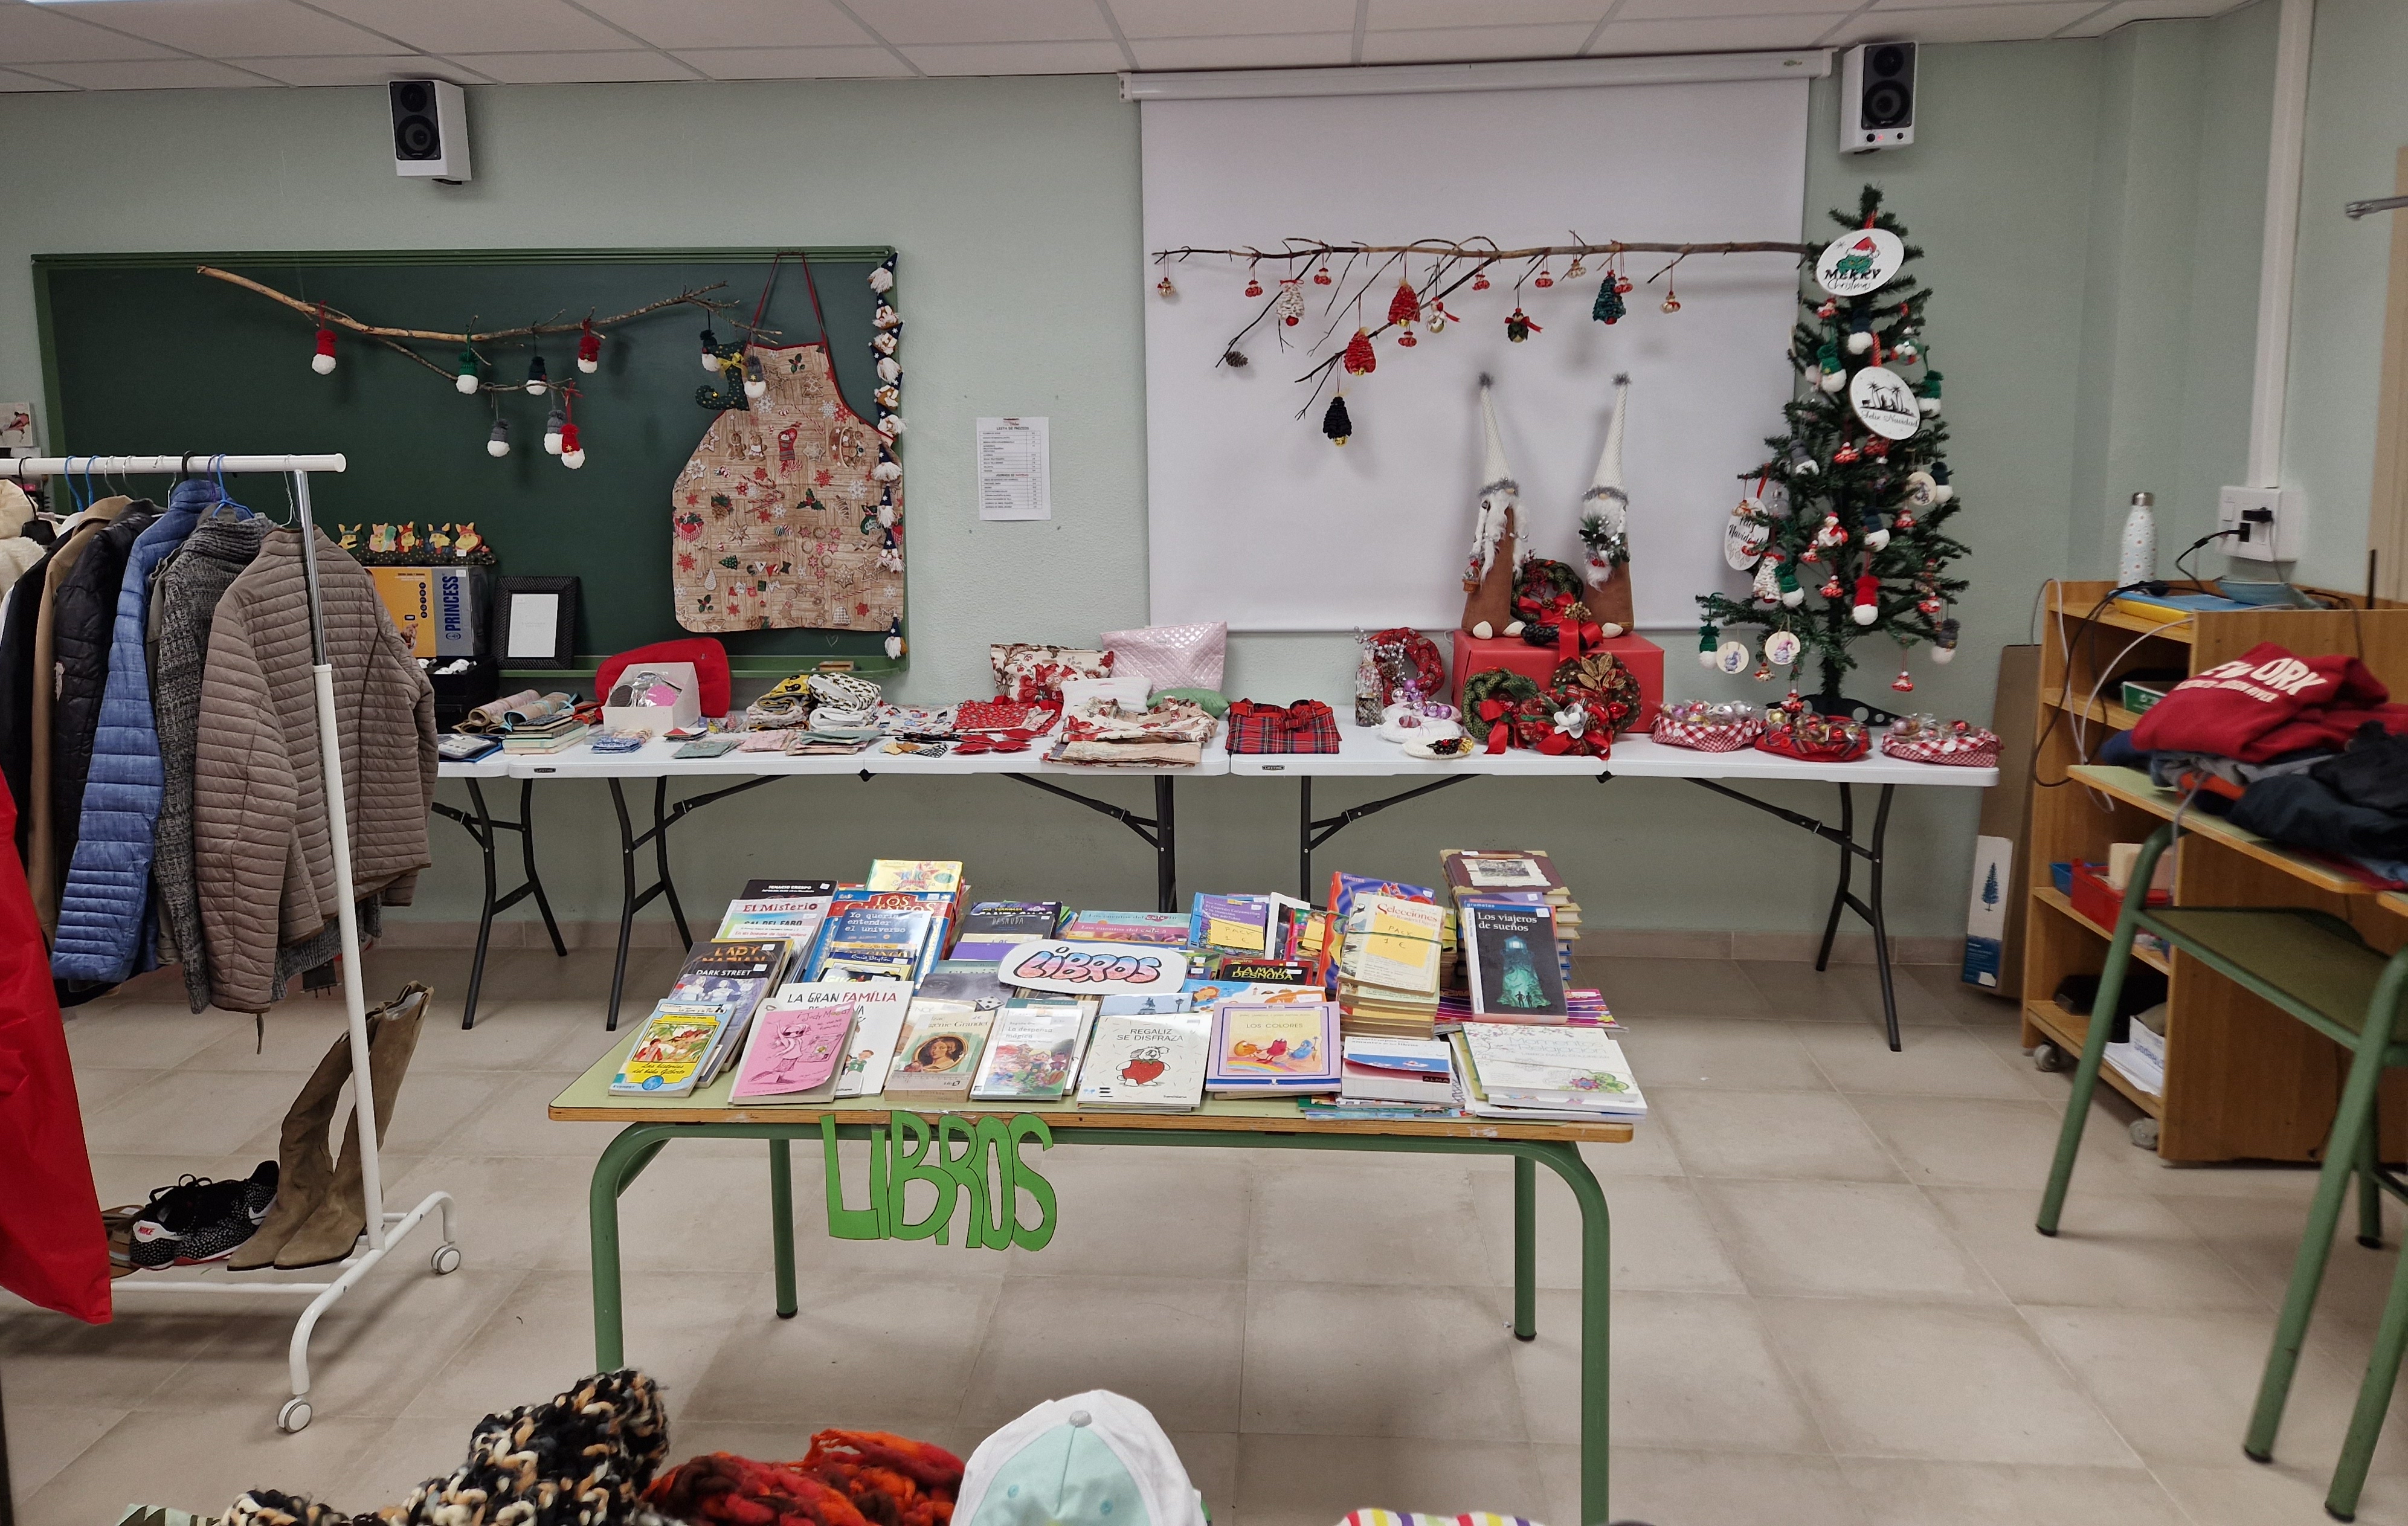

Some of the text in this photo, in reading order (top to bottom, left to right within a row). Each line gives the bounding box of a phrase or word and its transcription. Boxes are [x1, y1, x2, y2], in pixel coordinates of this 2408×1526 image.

[1824, 267, 1881, 281] MERRY
[1826, 278, 1873, 291] Christmas
[1861, 410, 1920, 427] Feliz Navidad
[442, 575, 461, 631] PRINCESS
[875, 895, 910, 907] LOS
[742, 903, 818, 912] El Misterio
[1377, 903, 1437, 922] Selecciones
[991, 916, 1024, 926] DESNUDA
[1477, 912, 1537, 924] Los viajeros
[1225, 927, 1254, 936] PACK
[1388, 926, 1413, 936] PACK
[1478, 921, 1529, 932] de sueños
[714, 945, 760, 956] LADY
[1013, 946, 1162, 984] LIBROS
[1231, 971, 1293, 980] DESNUDA
[787, 991, 897, 1003] LA GRAN FAMÍLIA
[1510, 1037, 1604, 1048] Momentos
[1518, 1043, 1607, 1054] Relajación
[819, 1110, 1057, 1252] LIBROS
[137, 1225, 155, 1236] NIKE
